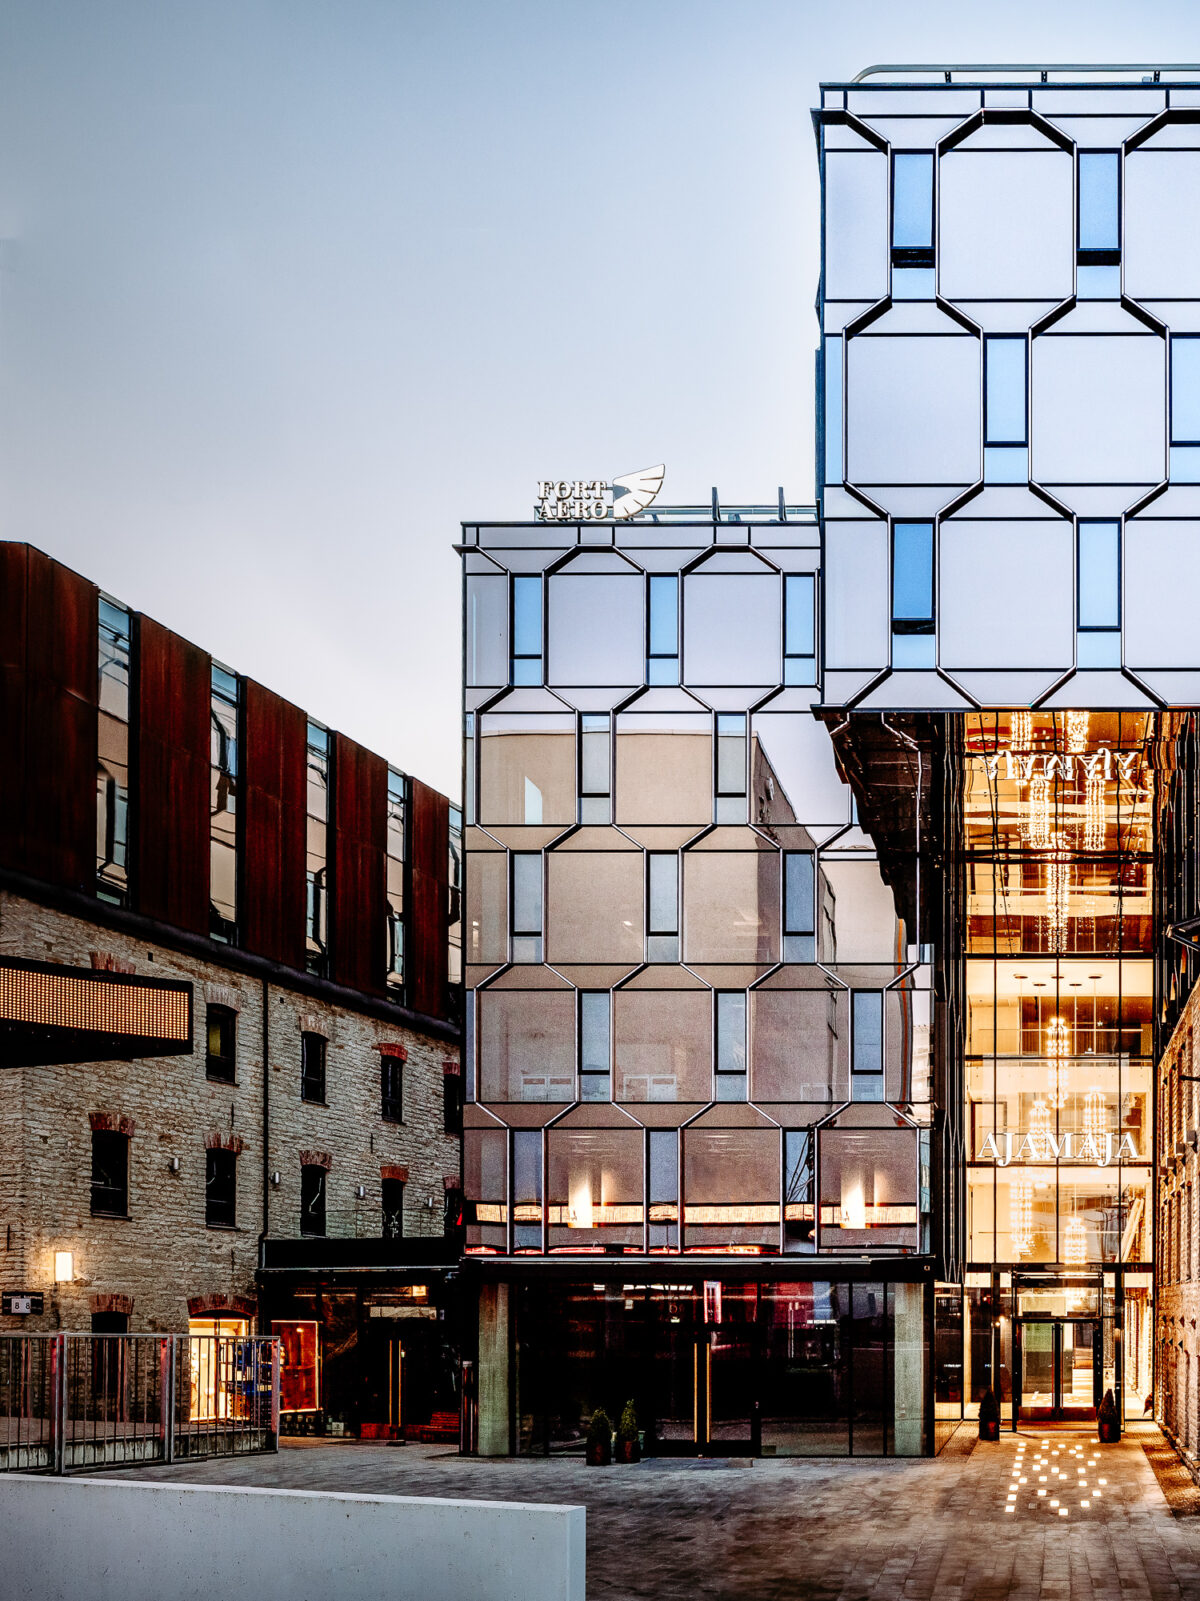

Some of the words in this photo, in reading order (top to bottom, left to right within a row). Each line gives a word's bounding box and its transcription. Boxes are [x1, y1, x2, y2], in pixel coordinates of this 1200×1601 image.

[537, 480, 607, 501] FORT
[539, 500, 608, 519] AERO
[977, 1132, 1139, 1166] AJAMAJA
